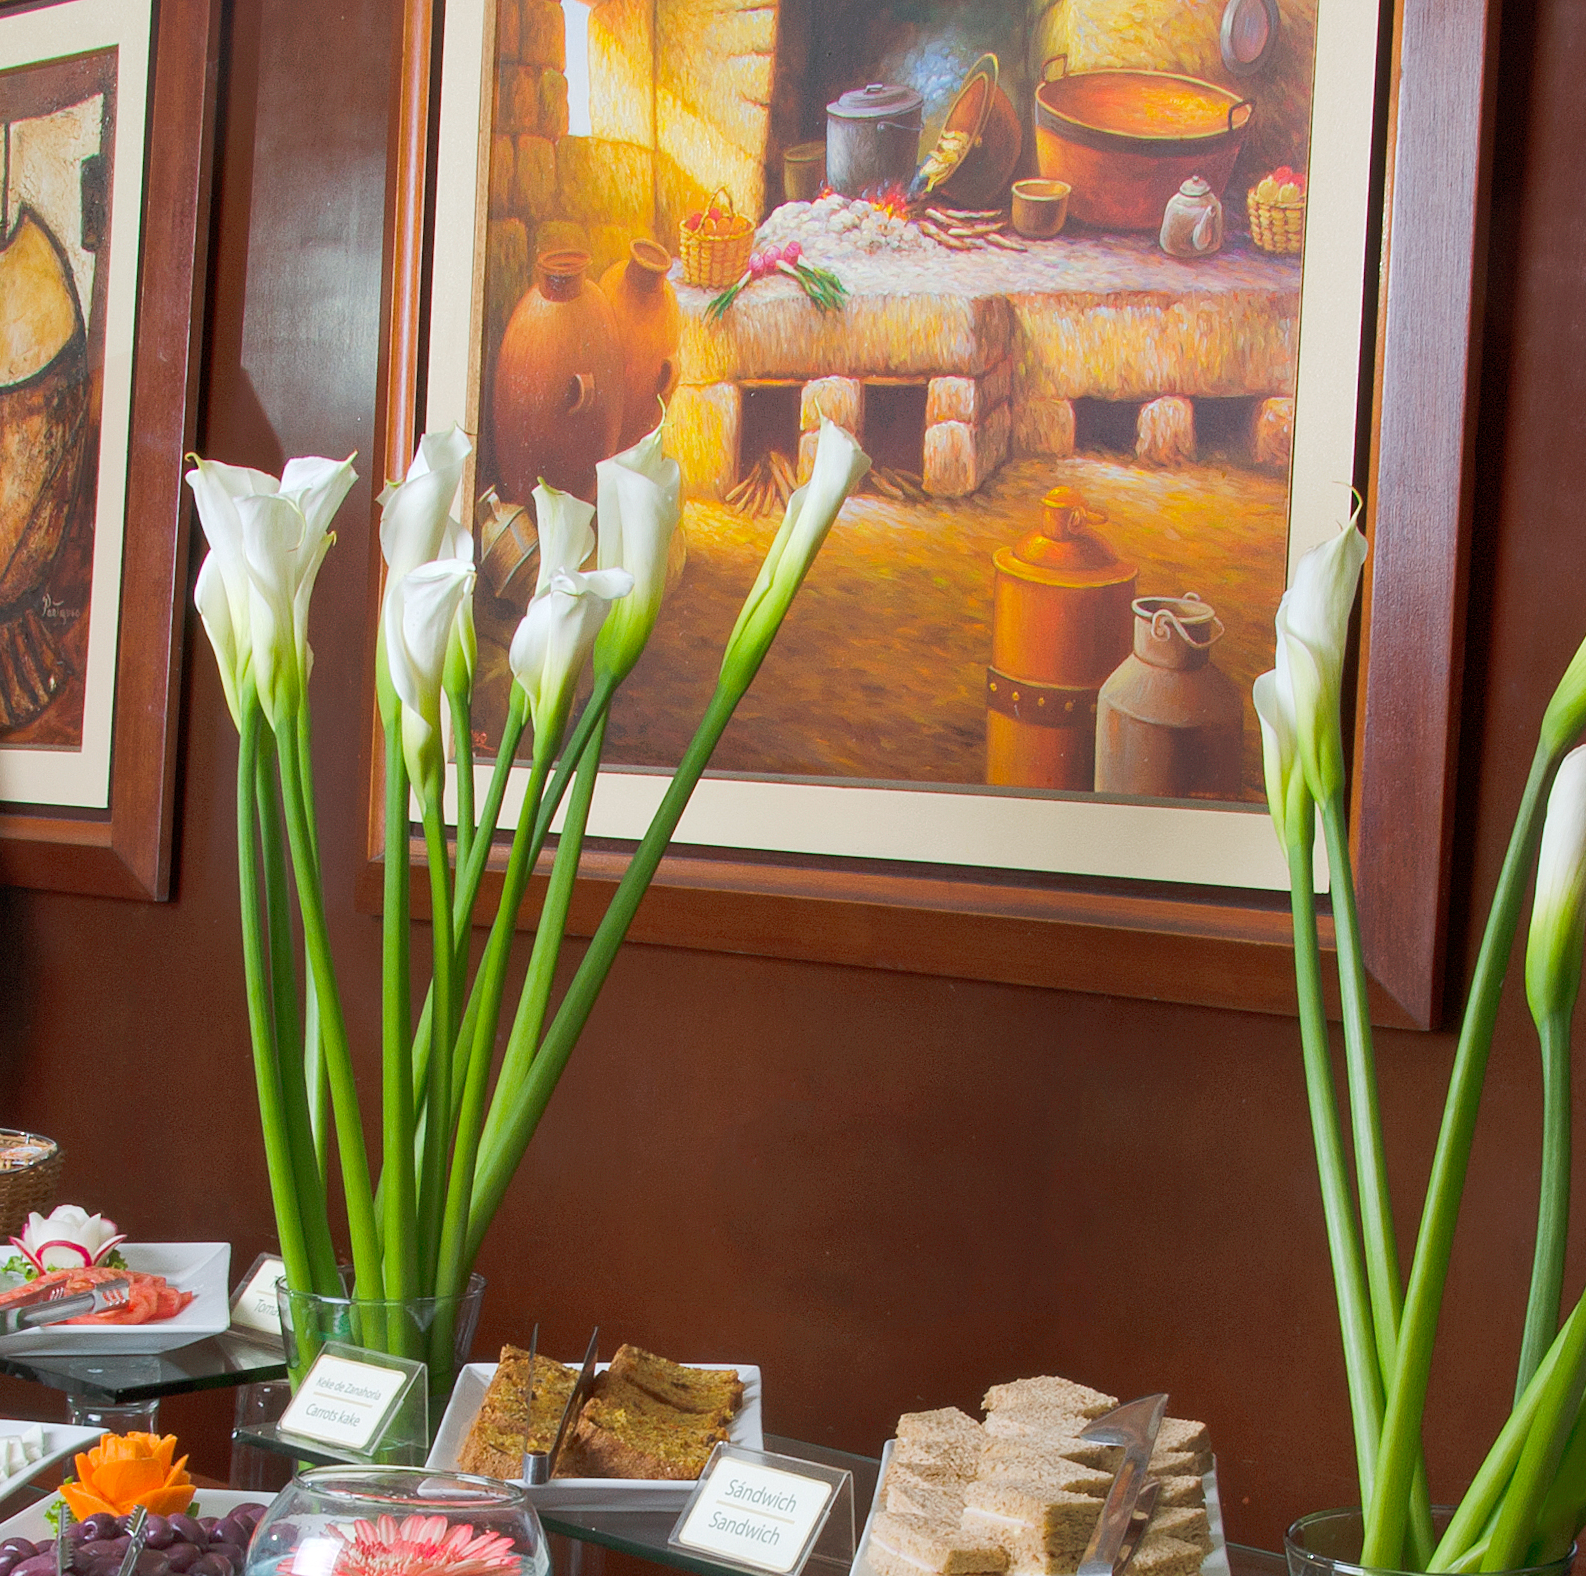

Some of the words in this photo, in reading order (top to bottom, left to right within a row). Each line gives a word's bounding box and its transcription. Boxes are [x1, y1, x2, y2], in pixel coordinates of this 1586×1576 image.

[254, 1299, 280, 1317] Toma
[316, 1376, 335, 1390] Keke
[334, 1381, 345, 1392] de
[305, 1403, 339, 1421] Carrots
[337, 1410, 361, 1427] kake
[725, 1478, 797, 1513] Sándwich
[708, 1511, 780, 1546] Sandwich
